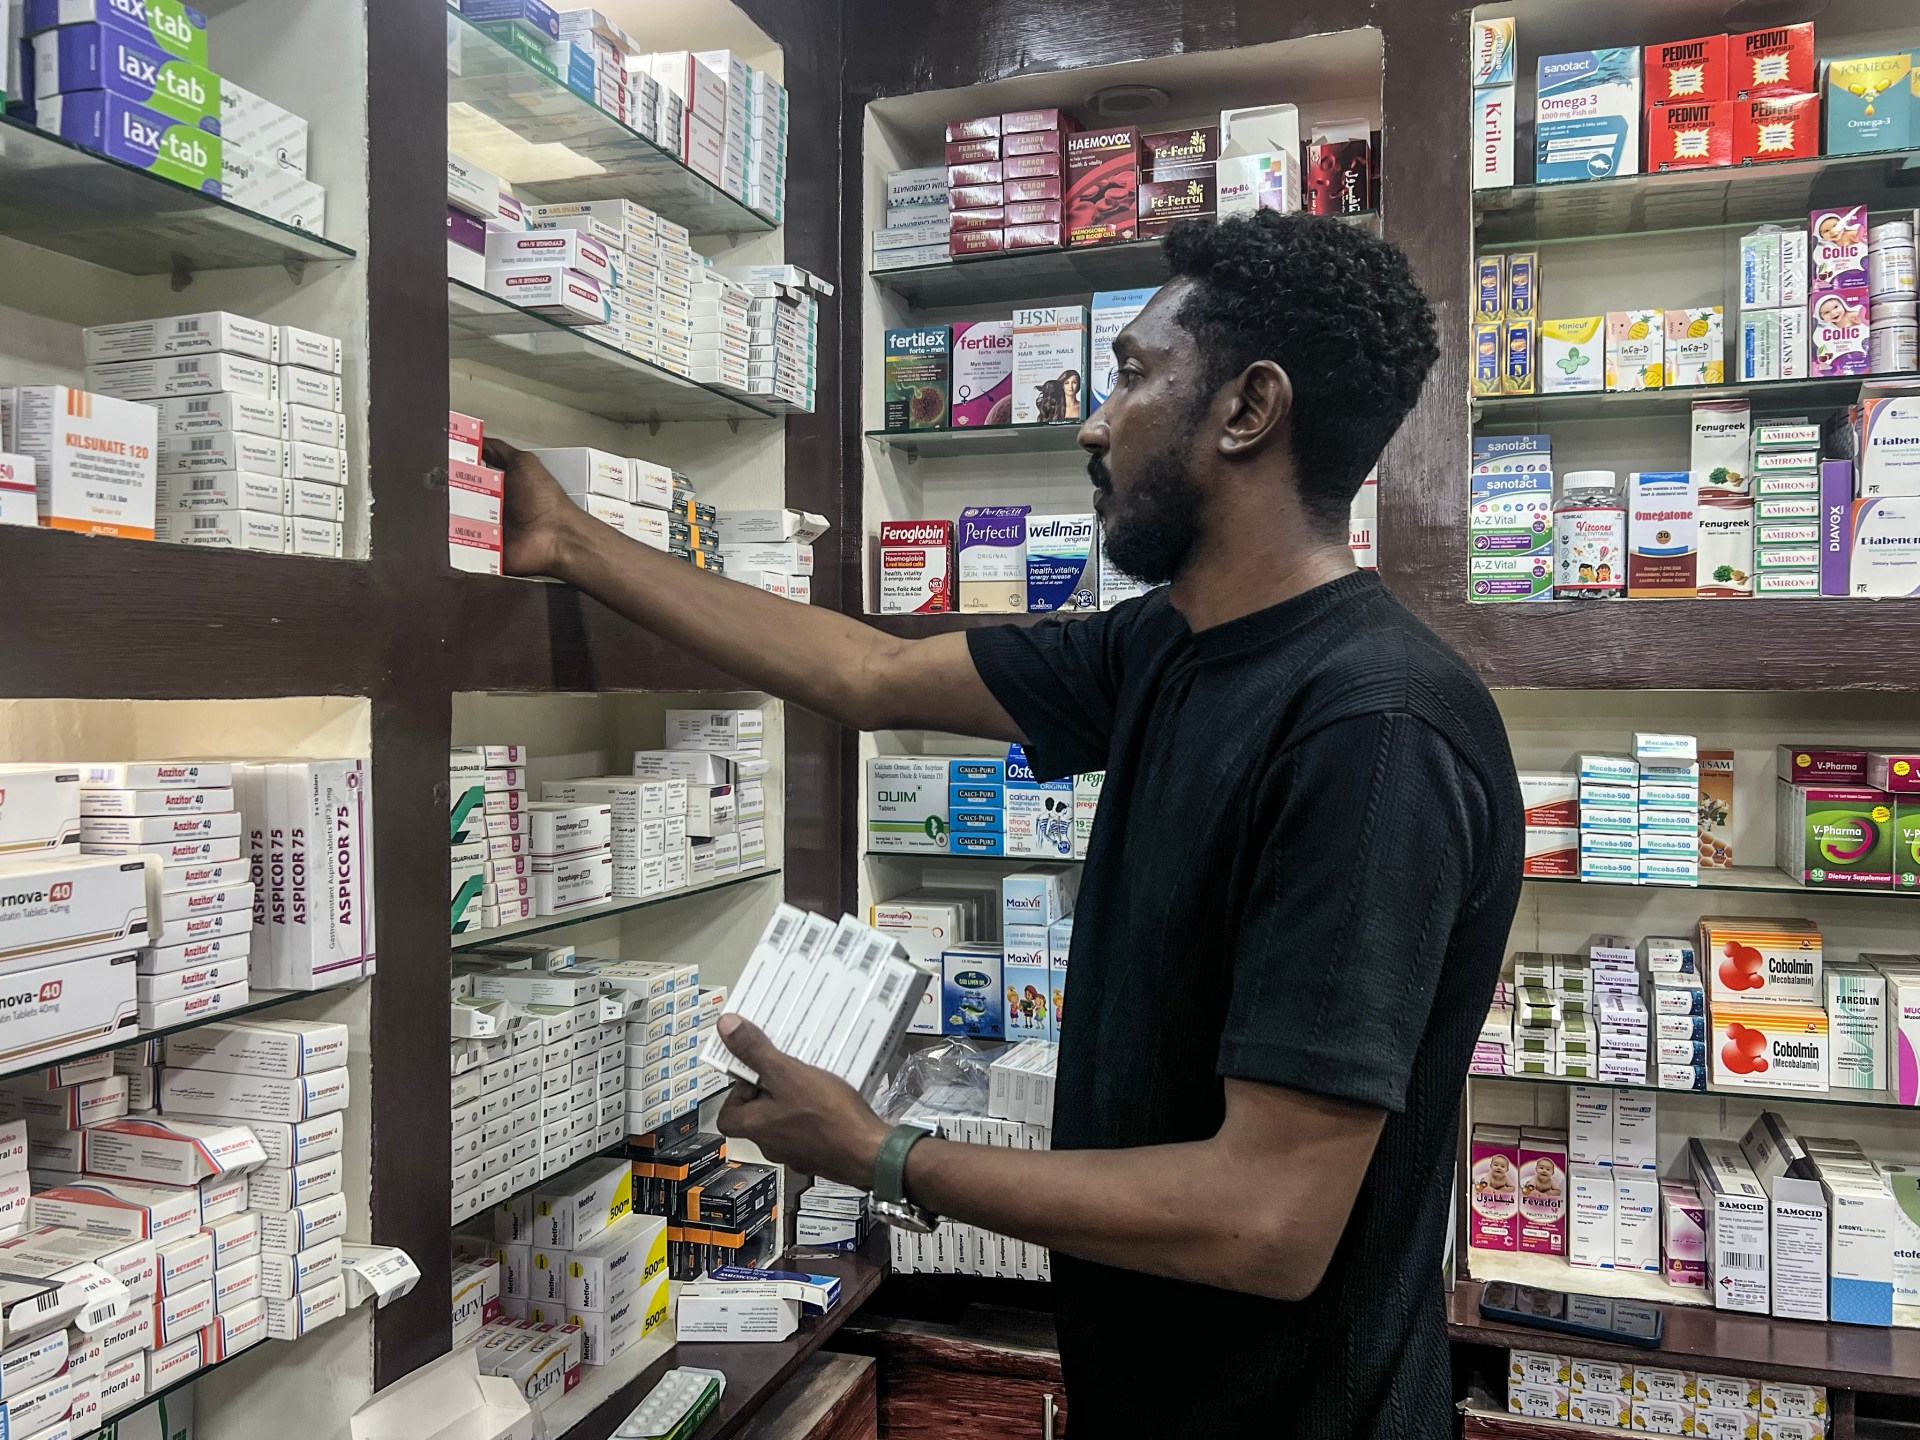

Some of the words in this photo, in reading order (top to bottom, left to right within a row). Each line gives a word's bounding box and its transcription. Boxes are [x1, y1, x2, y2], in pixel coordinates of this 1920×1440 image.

[1746, 30, 1789, 50] PEDIVIT
[1481, 28, 1493, 76] Krilom
[1662, 42, 1704, 62] PEDIVIT
[1766, 45, 1794, 54] CAPSULES
[1544, 60, 1590, 73] sanotact
[1681, 57, 1709, 66] CAPSULES
[119, 45, 206, 105] lax-tab
[1541, 97, 1586, 110] Omega
[1590, 94, 1598, 105] 3
[1016, 115, 1043, 123] FERRON
[1668, 106, 1710, 123] PEDIVIT
[1848, 117, 1890, 128] Omega-3
[123, 112, 208, 167] lax-tab
[1017, 135, 1044, 144] FERRON
[1069, 133, 1131, 151] HAEMOVOX
[1485, 102, 1502, 174] Krilom
[1155, 143, 1206, 159] Fe-Ferrol
[1018, 159, 1044, 167] FERRON
[1221, 184, 1249, 195] Mag-B6
[1151, 193, 1203, 208] Fe-Ferrol
[1823, 246, 1858, 259] Colic
[1784, 290, 1791, 301] 30
[1020, 309, 1057, 326] HSN
[1096, 324, 1119, 334] Burly
[1558, 322, 1587, 330] Minicuf
[890, 332, 944, 348] fertilex
[1823, 328, 1859, 341] Colic
[960, 335, 1012, 350] fertilex
[1681, 343, 1708, 352] Infa-D
[1621, 345, 1649, 354] Infa-D
[1696, 423, 1746, 432] Fenugreek
[1765, 431, 1816, 440] AMIRON+F
[66, 433, 126, 456] KILSUNATE
[129, 445, 149, 460] 120
[1488, 440, 1537, 451] sanotact
[1763, 457, 1813, 465] AMIRON+F
[1487, 477, 1537, 489] sanotact
[1765, 482, 1815, 490] AMIRON+F
[1635, 510, 1693, 521] Omegatone
[1765, 506, 1815, 514] AMIRON+F
[1473, 516, 1492, 525] A-Z
[1495, 516, 1516, 525] Vital
[1700, 520, 1750, 529] Fenugreek
[883, 526, 944, 543] Feroglobin
[966, 522, 1019, 545] Perfectil
[1030, 521, 1092, 538] wellman
[1830, 505, 1841, 552] DIAVOX
[1350, 530, 1370, 543] ull
[1765, 531, 1815, 539] AMIRON+F
[1766, 555, 1816, 563] AMIRON+F
[1474, 561, 1492, 570] A-Z
[1495, 561, 1516, 569] Vital
[1765, 580, 1816, 588] AMIRON+F
[1589, 765, 1631, 773] Mecoba-500
[1817, 762, 1857, 770] V-Pharma
[157, 768, 188, 778] Anzitor
[189, 767, 198, 777] 40
[165, 794, 193, 806] Anzitor
[195, 794, 204, 804] 40
[337, 806, 349, 830] 75
[173, 820, 201, 832] Anzitor
[203, 819, 211, 829] 40
[1813, 825, 1861, 835] V-Pharma
[251, 830, 263, 852] 75
[271, 829, 283, 850] 75
[292, 829, 303, 850] 75
[1590, 840, 1632, 848] Mecoba-500
[185, 869, 211, 881] Anzitor
[338, 834, 352, 925] ASPICOR
[1828, 873, 1851, 881] Dietary
[272, 852, 285, 925] ASPICOR
[292, 852, 306, 925] ASPICOR
[1006, 895, 1042, 908] MaxiVit
[187, 919, 212, 932] Anzitor
[1007, 951, 1043, 964] MaxiVit
[1596, 952, 1628, 960] Nuroton
[1769, 958, 1813, 974] Cobolmin
[1599, 975, 1632, 983] Nuroton
[1769, 975, 1814, 986] (Mecobalamin)
[1836, 996, 1880, 1005] FARCOLIN
[1607, 1015, 1640, 1023] Nuroton
[1606, 1040, 1640, 1048] Nuroton
[1773, 1041, 1819, 1059] Cobolmin
[1605, 1064, 1639, 1072] Nuroton
[1773, 1059, 1819, 1071] (Mecobalamin)
[578, 1191, 596, 1209] Metfor
[1523, 1197, 1561, 1208] Fevadol
[1719, 1201, 1763, 1211] SAMOCID
[1777, 1208, 1823, 1217] SAMOCID
[1897, 1287, 1918, 1295] tabuk
[104, 1325, 136, 1347] Emforal
[526, 1351, 567, 1399] Getryl
